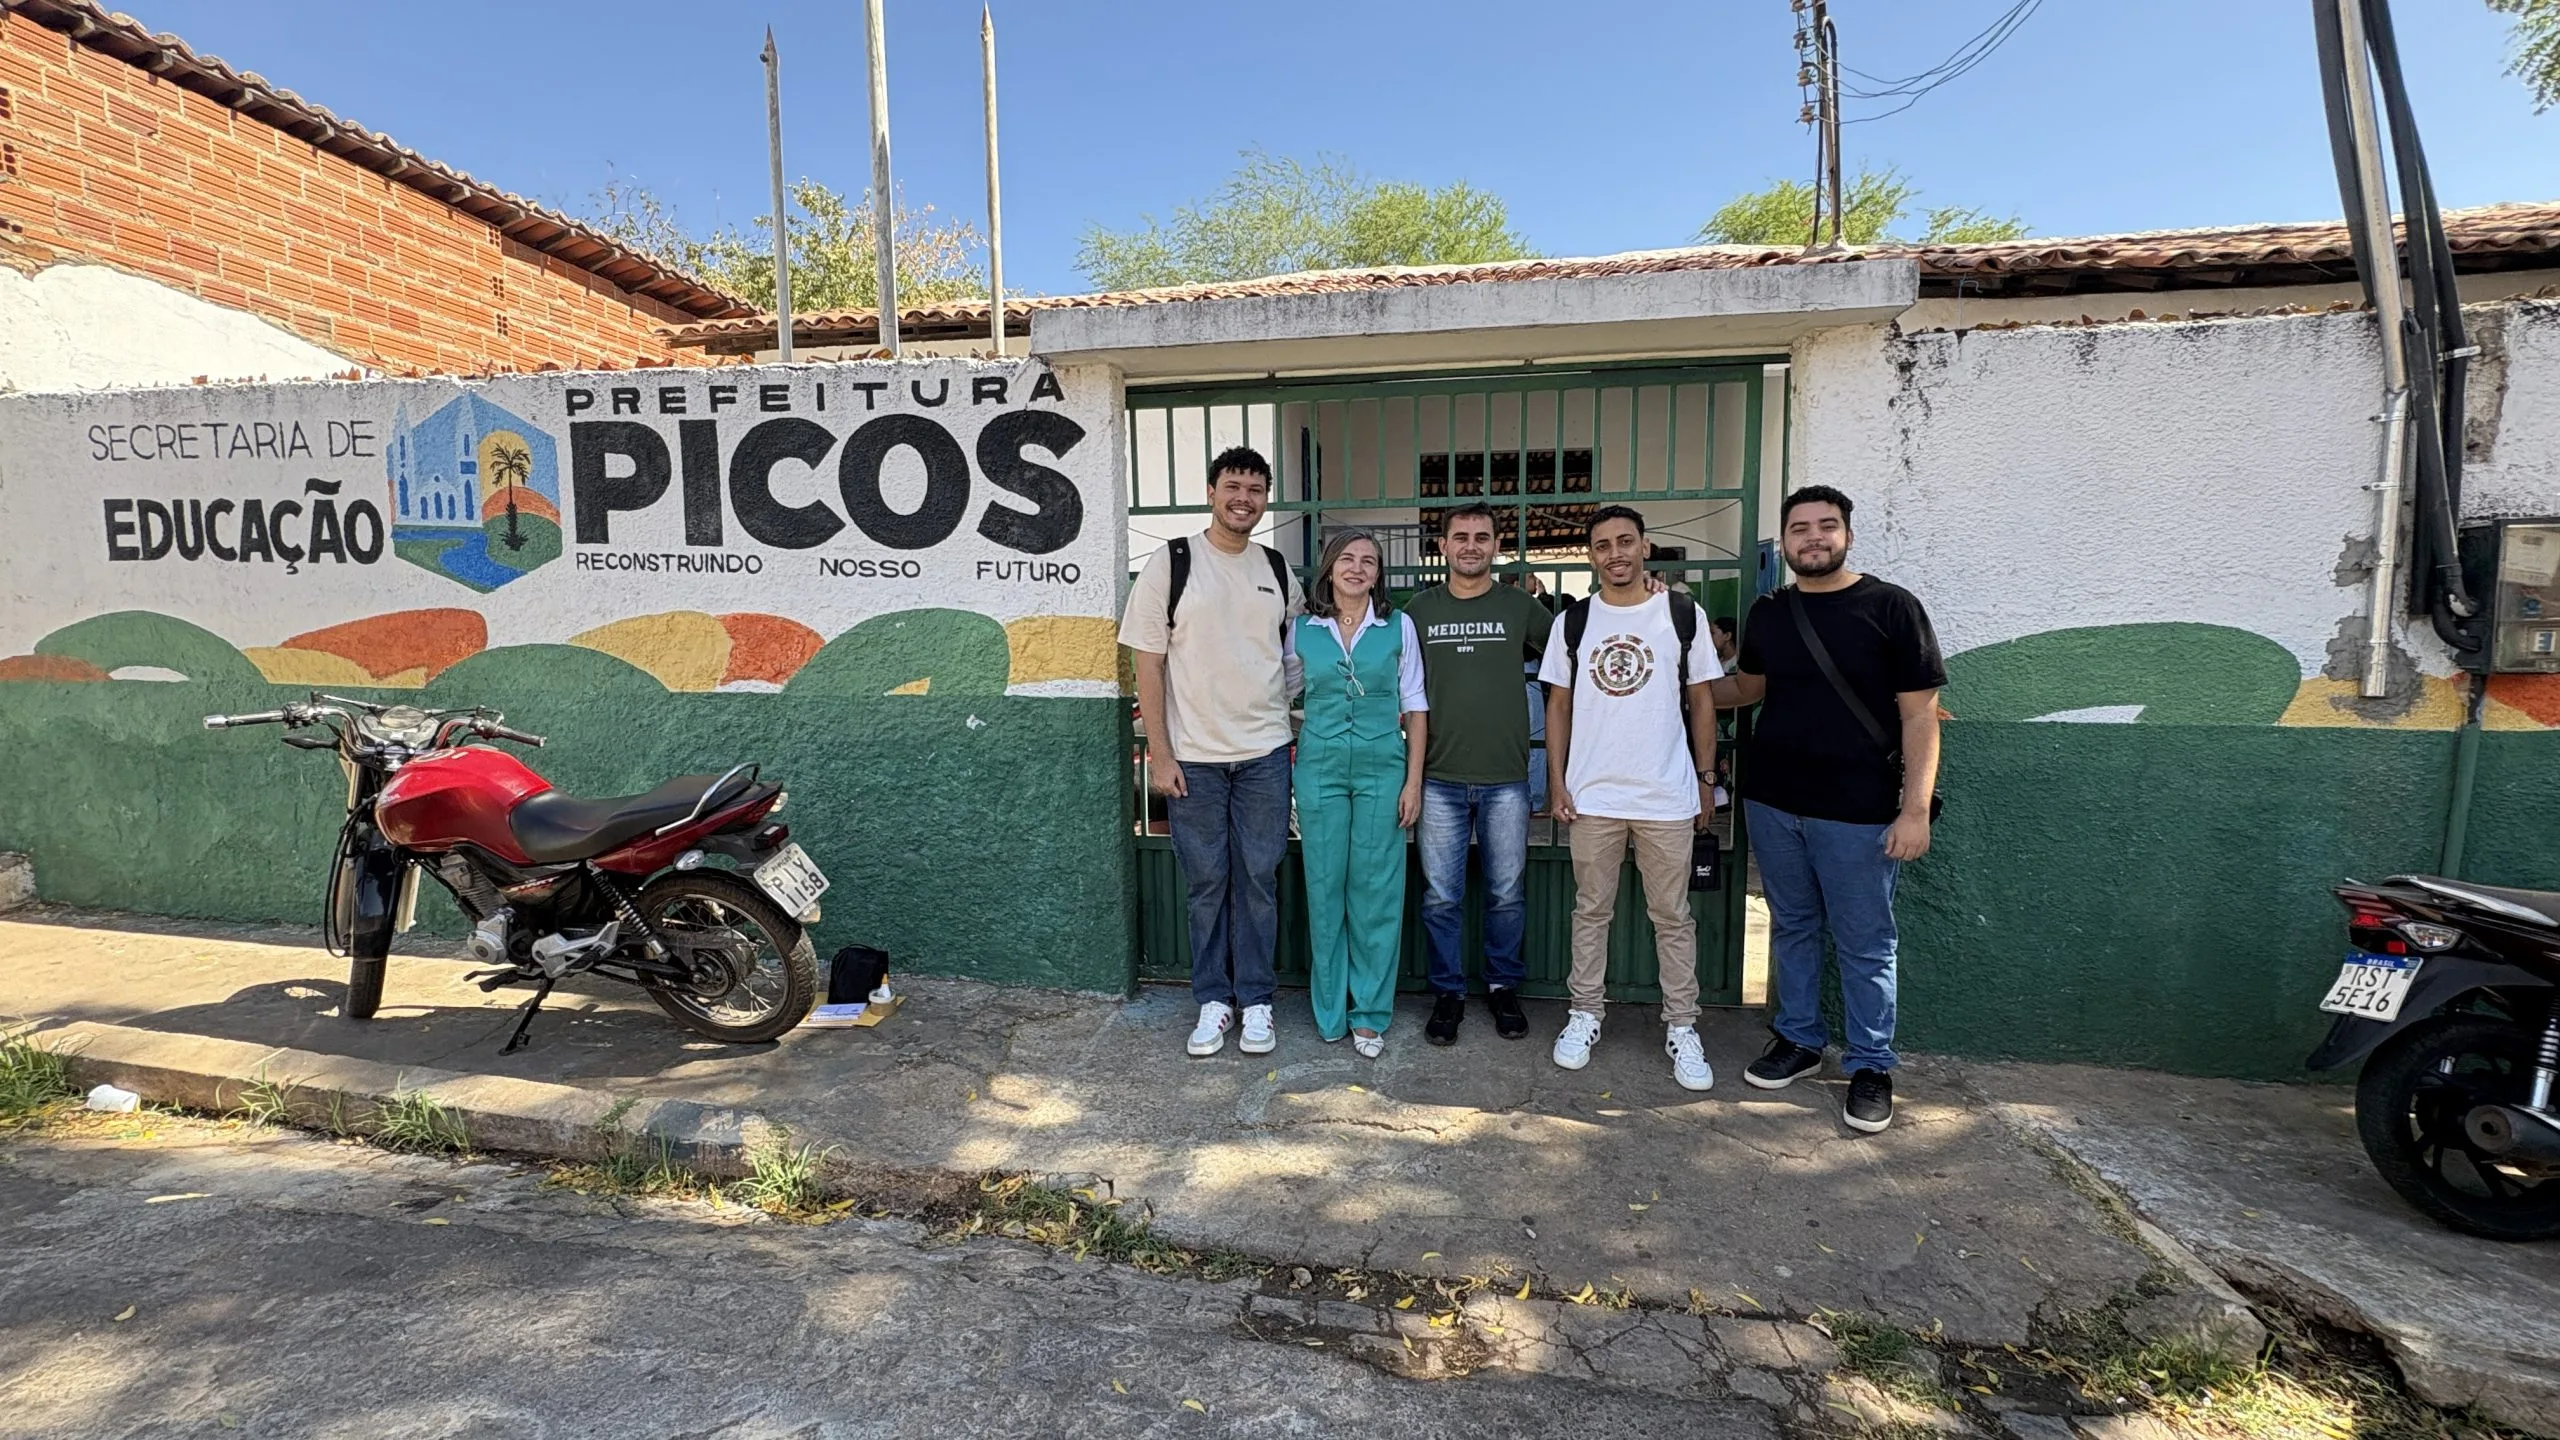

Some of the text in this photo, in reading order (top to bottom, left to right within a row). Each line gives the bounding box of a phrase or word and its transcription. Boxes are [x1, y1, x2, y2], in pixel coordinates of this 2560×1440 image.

[565, 371, 1065, 417] PREFEITURA
[88, 420, 377, 461] SECRETARIA DE
[569, 409, 1087, 555] PICOS
[103, 477, 385, 575] EDUCAÇÃO
[576, 551, 1081, 585] RECONSTRUINDO NOSSO FUTURO
[1427, 622, 1506, 638] MEDICINA
[1456, 645, 1475, 653] UFPI
[771, 857, 809, 895] PIY
[786, 871, 825, 909] 1158
[2350, 965, 2398, 989] RST
[2366, 958, 2396, 968] BRASIL
[2329, 986, 2393, 1012] 5E16
